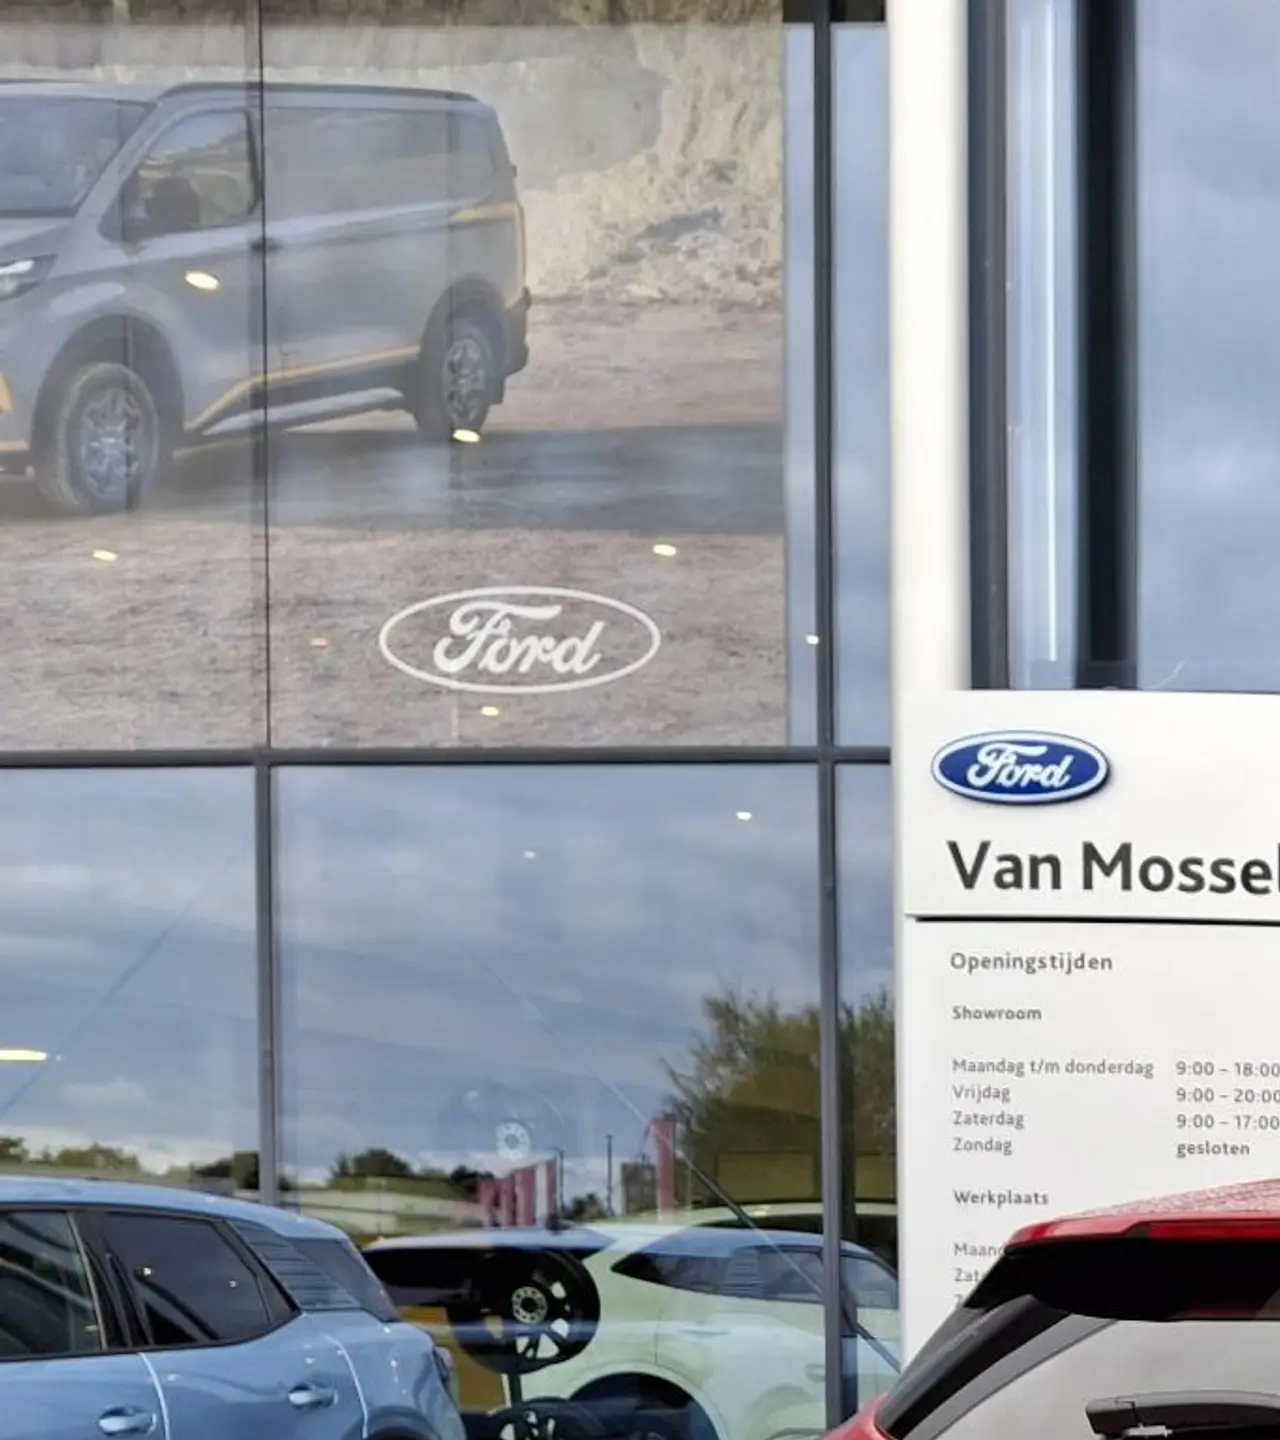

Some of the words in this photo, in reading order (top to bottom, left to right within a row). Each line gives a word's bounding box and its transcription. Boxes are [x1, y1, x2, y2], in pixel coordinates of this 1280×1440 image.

[432, 600, 605, 676] Ford
[966, 741, 1075, 788] Ford
[946, 839, 1062, 890] Van
[950, 951, 1113, 975] Openingstijden
[952, 1005, 1043, 1021] Showroom
[952, 1058, 1025, 1077] Maandag
[1030, 1058, 1060, 1074] t/m
[1065, 1058, 1154, 1079] donderdag
[1176, 1061, 1214, 1076] 9:00
[1234, 1062, 1280, 1078] 18:00
[952, 1084, 1010, 1104] Vrijdag
[1176, 1087, 1214, 1102] 9:00
[952, 1110, 1024, 1130] Zaterdag
[1176, 1114, 1214, 1129] 9:00
[1234, 1115, 1280, 1130] 17:00
[952, 1137, 1012, 1156] Zondag
[1176, 1140, 1250, 1158] gesloten
[954, 1188, 1049, 1207] Werkplaats
